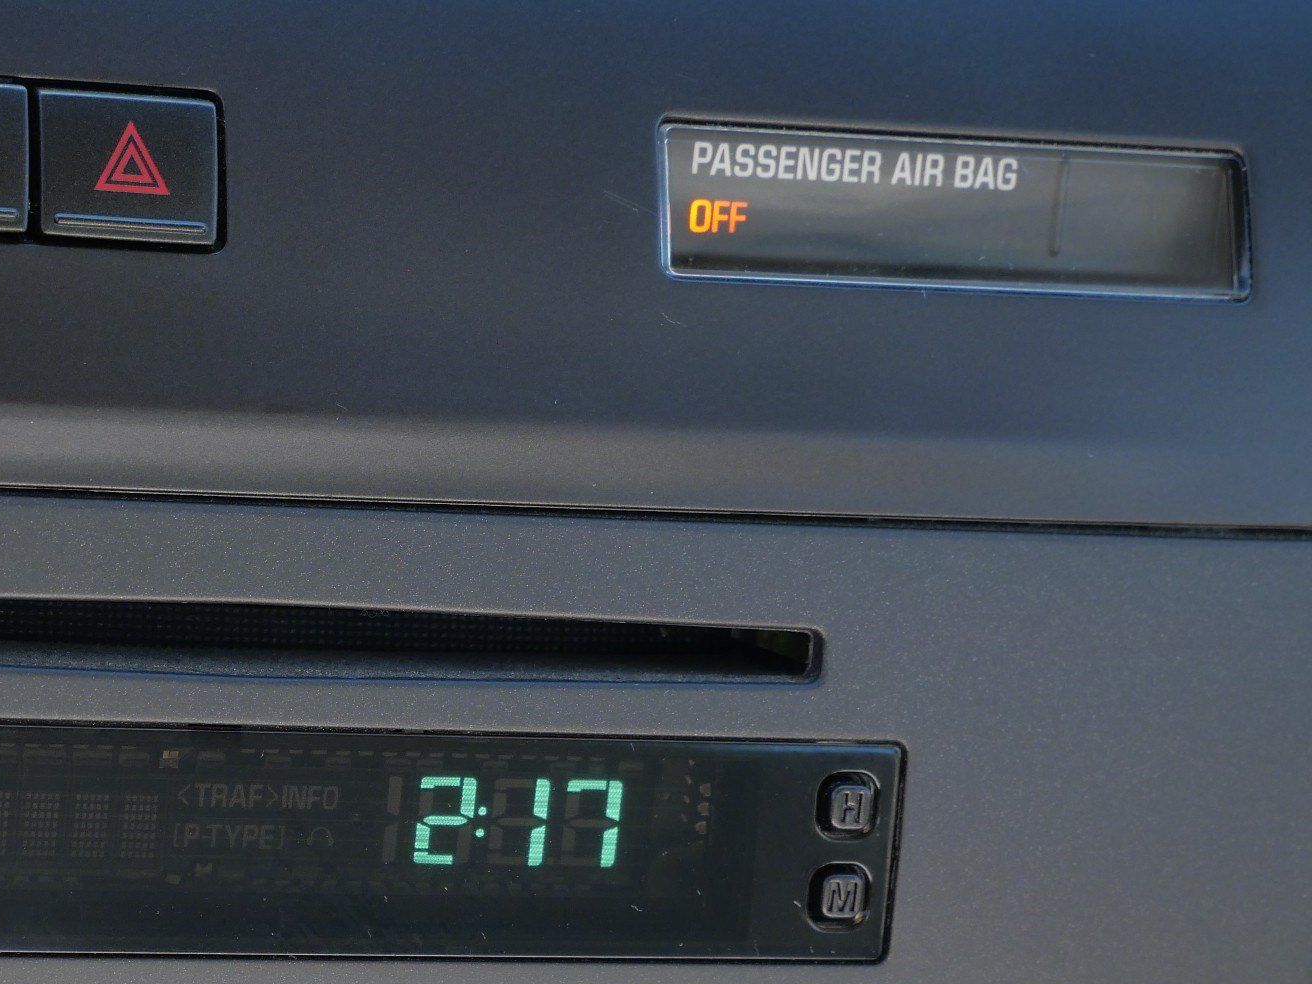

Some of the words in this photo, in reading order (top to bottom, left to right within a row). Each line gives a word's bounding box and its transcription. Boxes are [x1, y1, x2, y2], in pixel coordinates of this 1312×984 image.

[691, 141, 882, 184] PASSENGER
[891, 151, 944, 188] AIR
[954, 155, 1019, 192] BAG
[688, 198, 749, 235] OFF
[413, 776, 624, 868] 2:17
[840, 790, 864, 823] H
[828, 881, 858, 912] M
